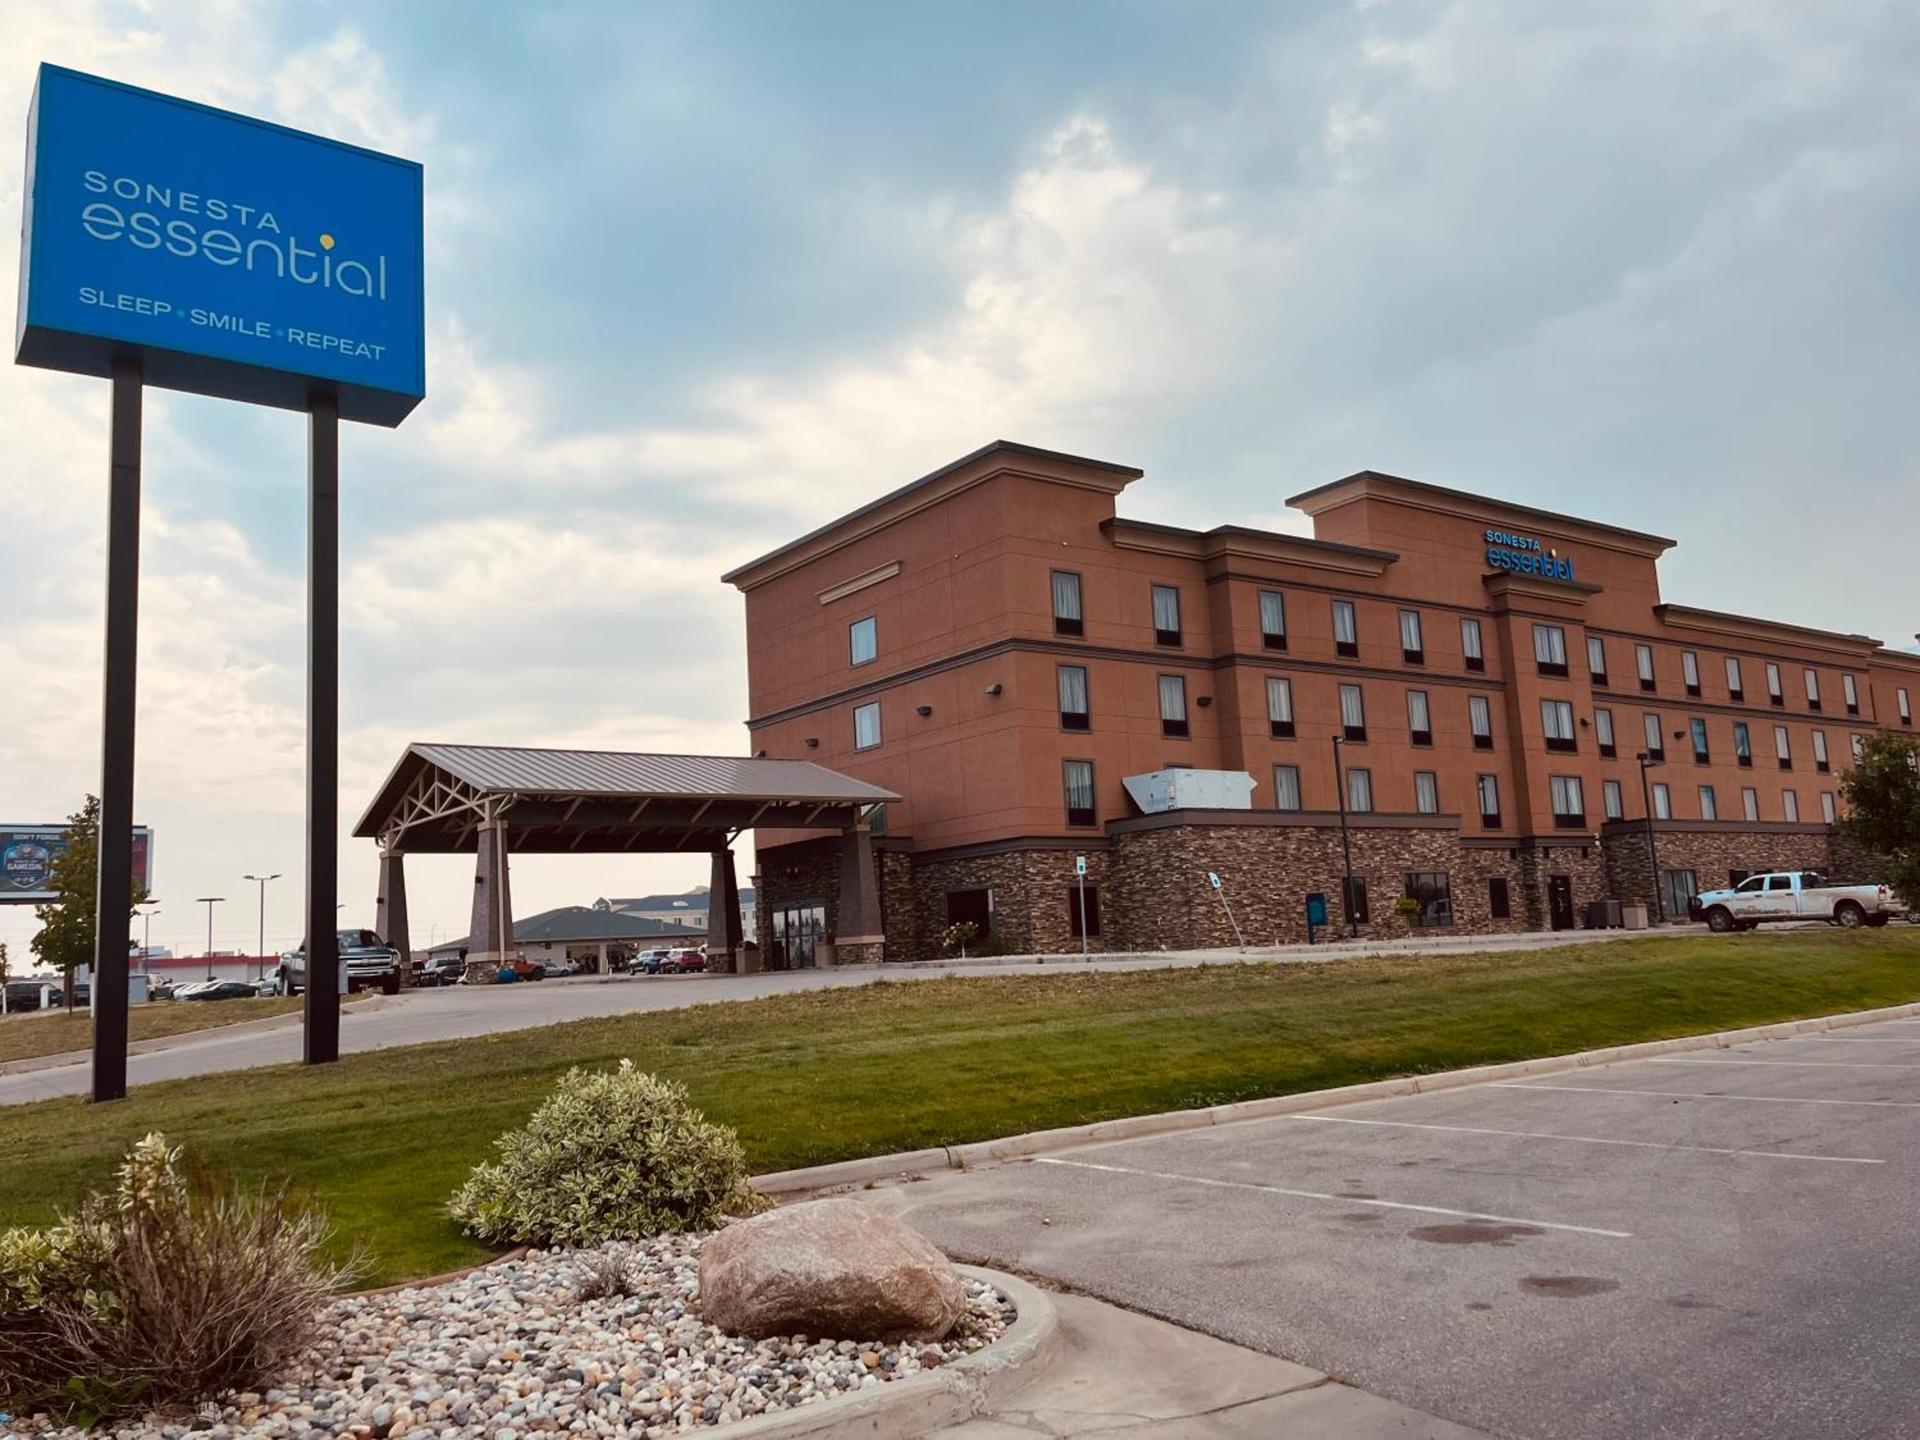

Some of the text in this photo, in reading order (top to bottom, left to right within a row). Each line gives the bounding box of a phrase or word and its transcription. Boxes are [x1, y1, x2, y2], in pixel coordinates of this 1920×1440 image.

[84, 171, 280, 234] SONESTA
[82, 203, 386, 300] essential
[79, 287, 386, 361] SLEEP SMILE REPEAT
[1486, 530, 1541, 551] SONESTA
[1487, 547, 1574, 581] essential
